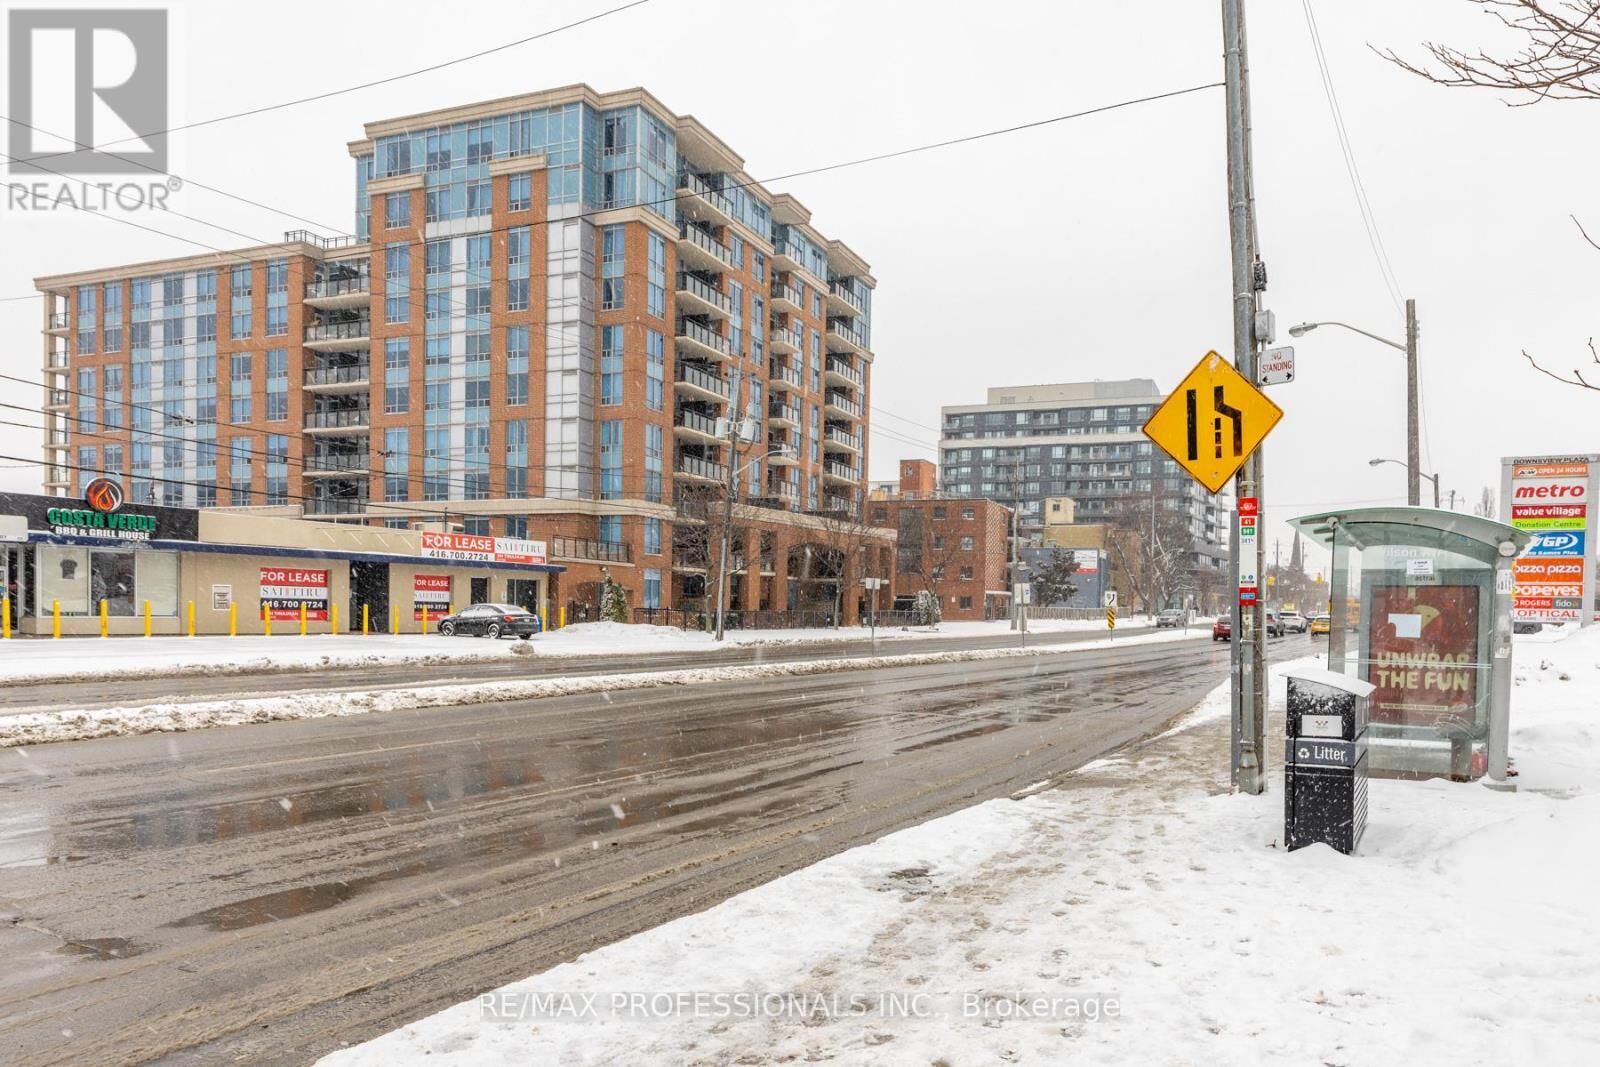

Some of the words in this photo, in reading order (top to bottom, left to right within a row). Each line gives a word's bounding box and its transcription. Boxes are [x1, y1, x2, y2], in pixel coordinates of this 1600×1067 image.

[1262, 361, 1292, 373] STANDING
[1515, 485, 1585, 498] metro
[1516, 508, 1544, 516] value
[1546, 506, 1581, 516] village
[47, 508, 105, 528] COSTA
[55, 526, 78, 536] BBQ
[89, 528, 116, 538] GRILL
[118, 531, 150, 540] HOUSE
[426, 534, 452, 548] FOR
[455, 537, 492, 551] LEASE
[429, 550, 489, 560] 416.700.2724
[1547, 565, 1581, 575] pizza
[260, 571, 285, 581] FOR
[288, 573, 326, 583] LEASE
[261, 600, 323, 608] 416.7002724
[1517, 609, 1579, 617] OPTICAL
[1377, 652, 1470, 670] UNWRAP
[1377, 670, 1418, 690] THE
[1424, 672, 1470, 691] FUN
[1314, 745, 1346, 762] Litter
